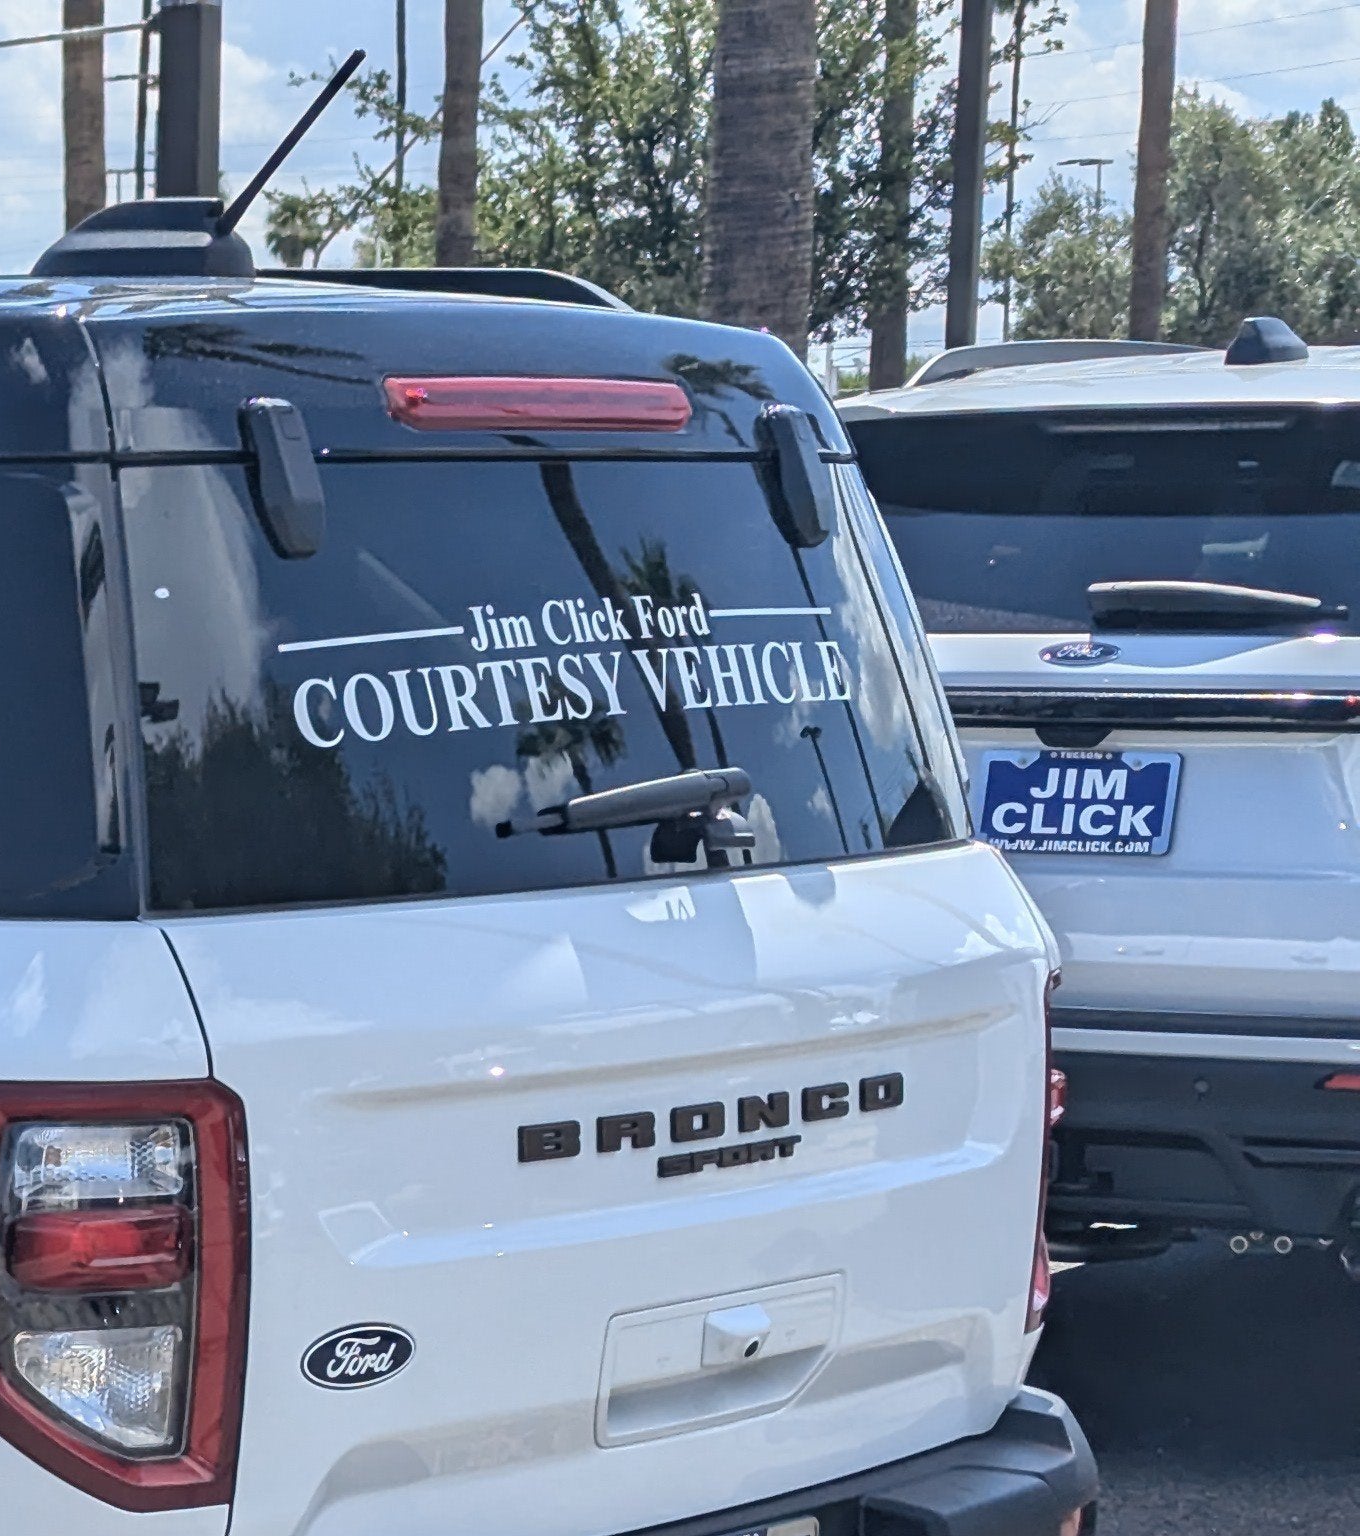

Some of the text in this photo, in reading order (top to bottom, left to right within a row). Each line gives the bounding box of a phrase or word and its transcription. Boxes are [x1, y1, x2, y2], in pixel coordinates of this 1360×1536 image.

[468, 592, 711, 652] Jim Click Ford
[293, 641, 851, 748] COURTESY VEHICLE
[1030, 767, 1128, 800] JIM
[991, 802, 1155, 837] CLICK
[517, 1072, 904, 1163] BRONCO
[657, 1134, 802, 1179] SPORT
[326, 1335, 397, 1379] Ford
